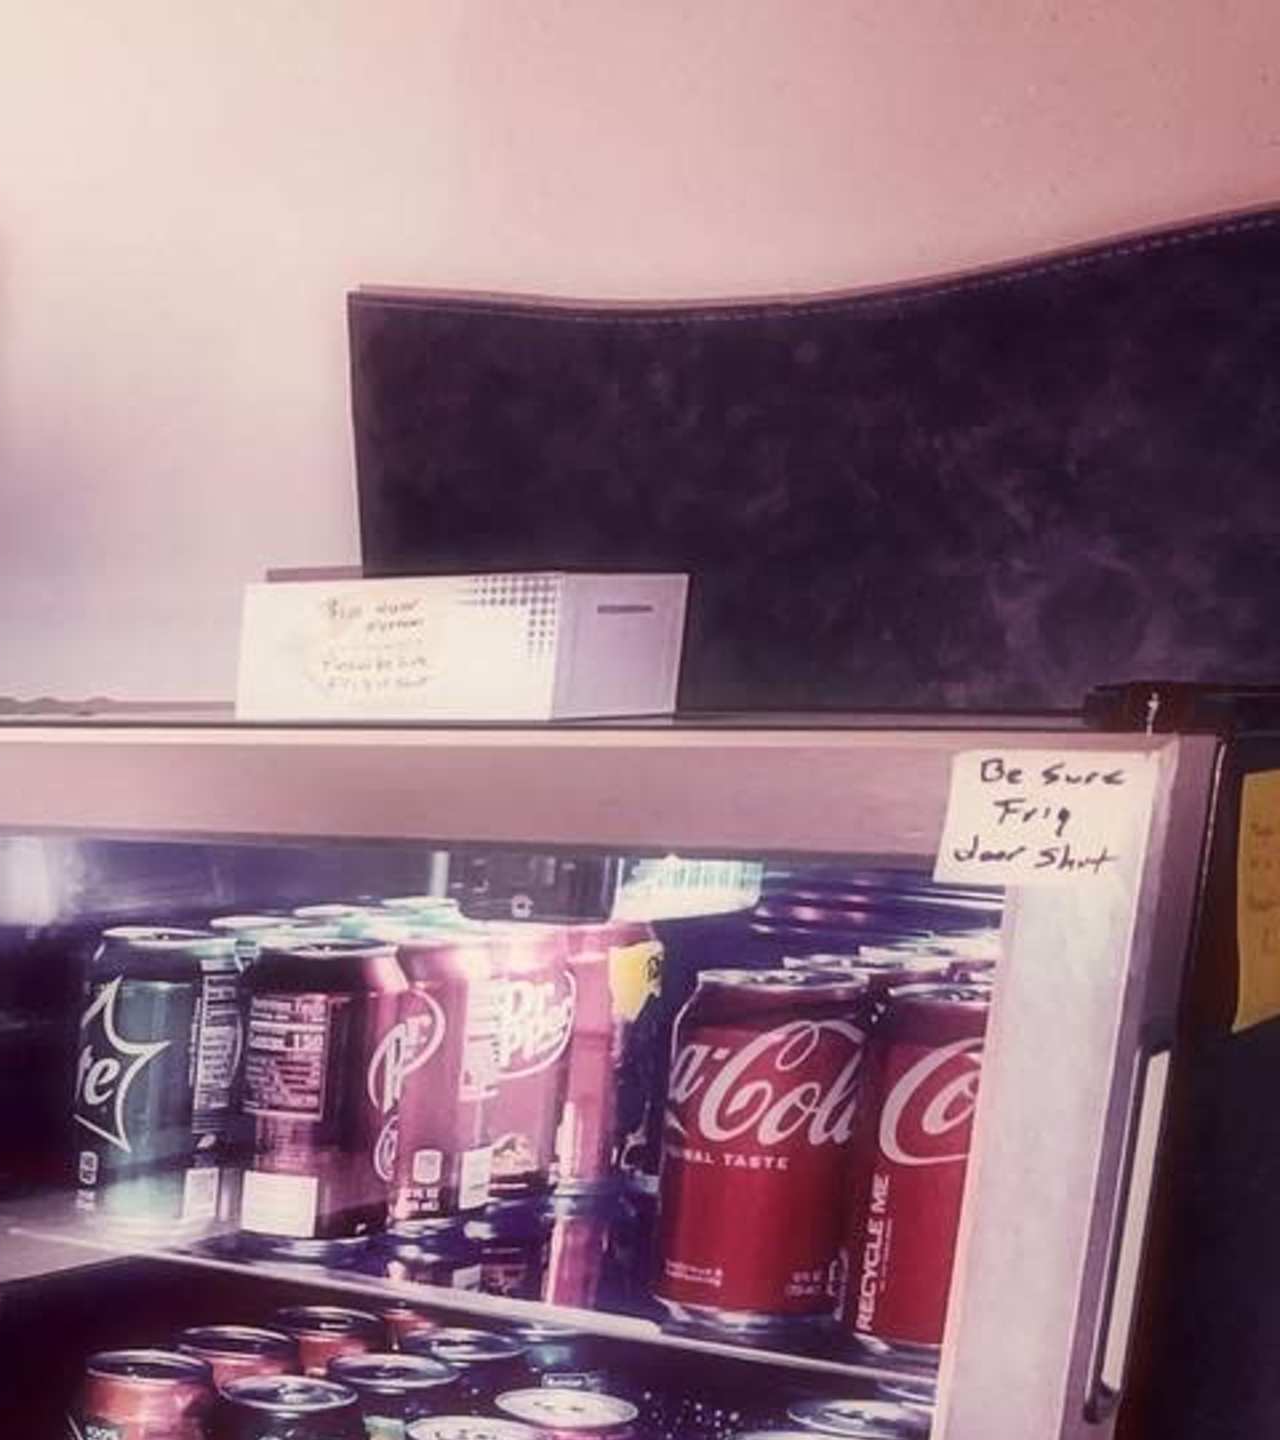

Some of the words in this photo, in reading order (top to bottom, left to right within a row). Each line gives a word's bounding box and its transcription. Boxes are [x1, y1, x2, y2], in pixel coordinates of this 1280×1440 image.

[980, 758, 1023, 785] Be
[992, 798, 1072, 838] Frig
[723, 1152, 789, 1169] TASTE
[870, 1173, 889, 1215] ME
[856, 1217, 885, 1332] RECYCLE
